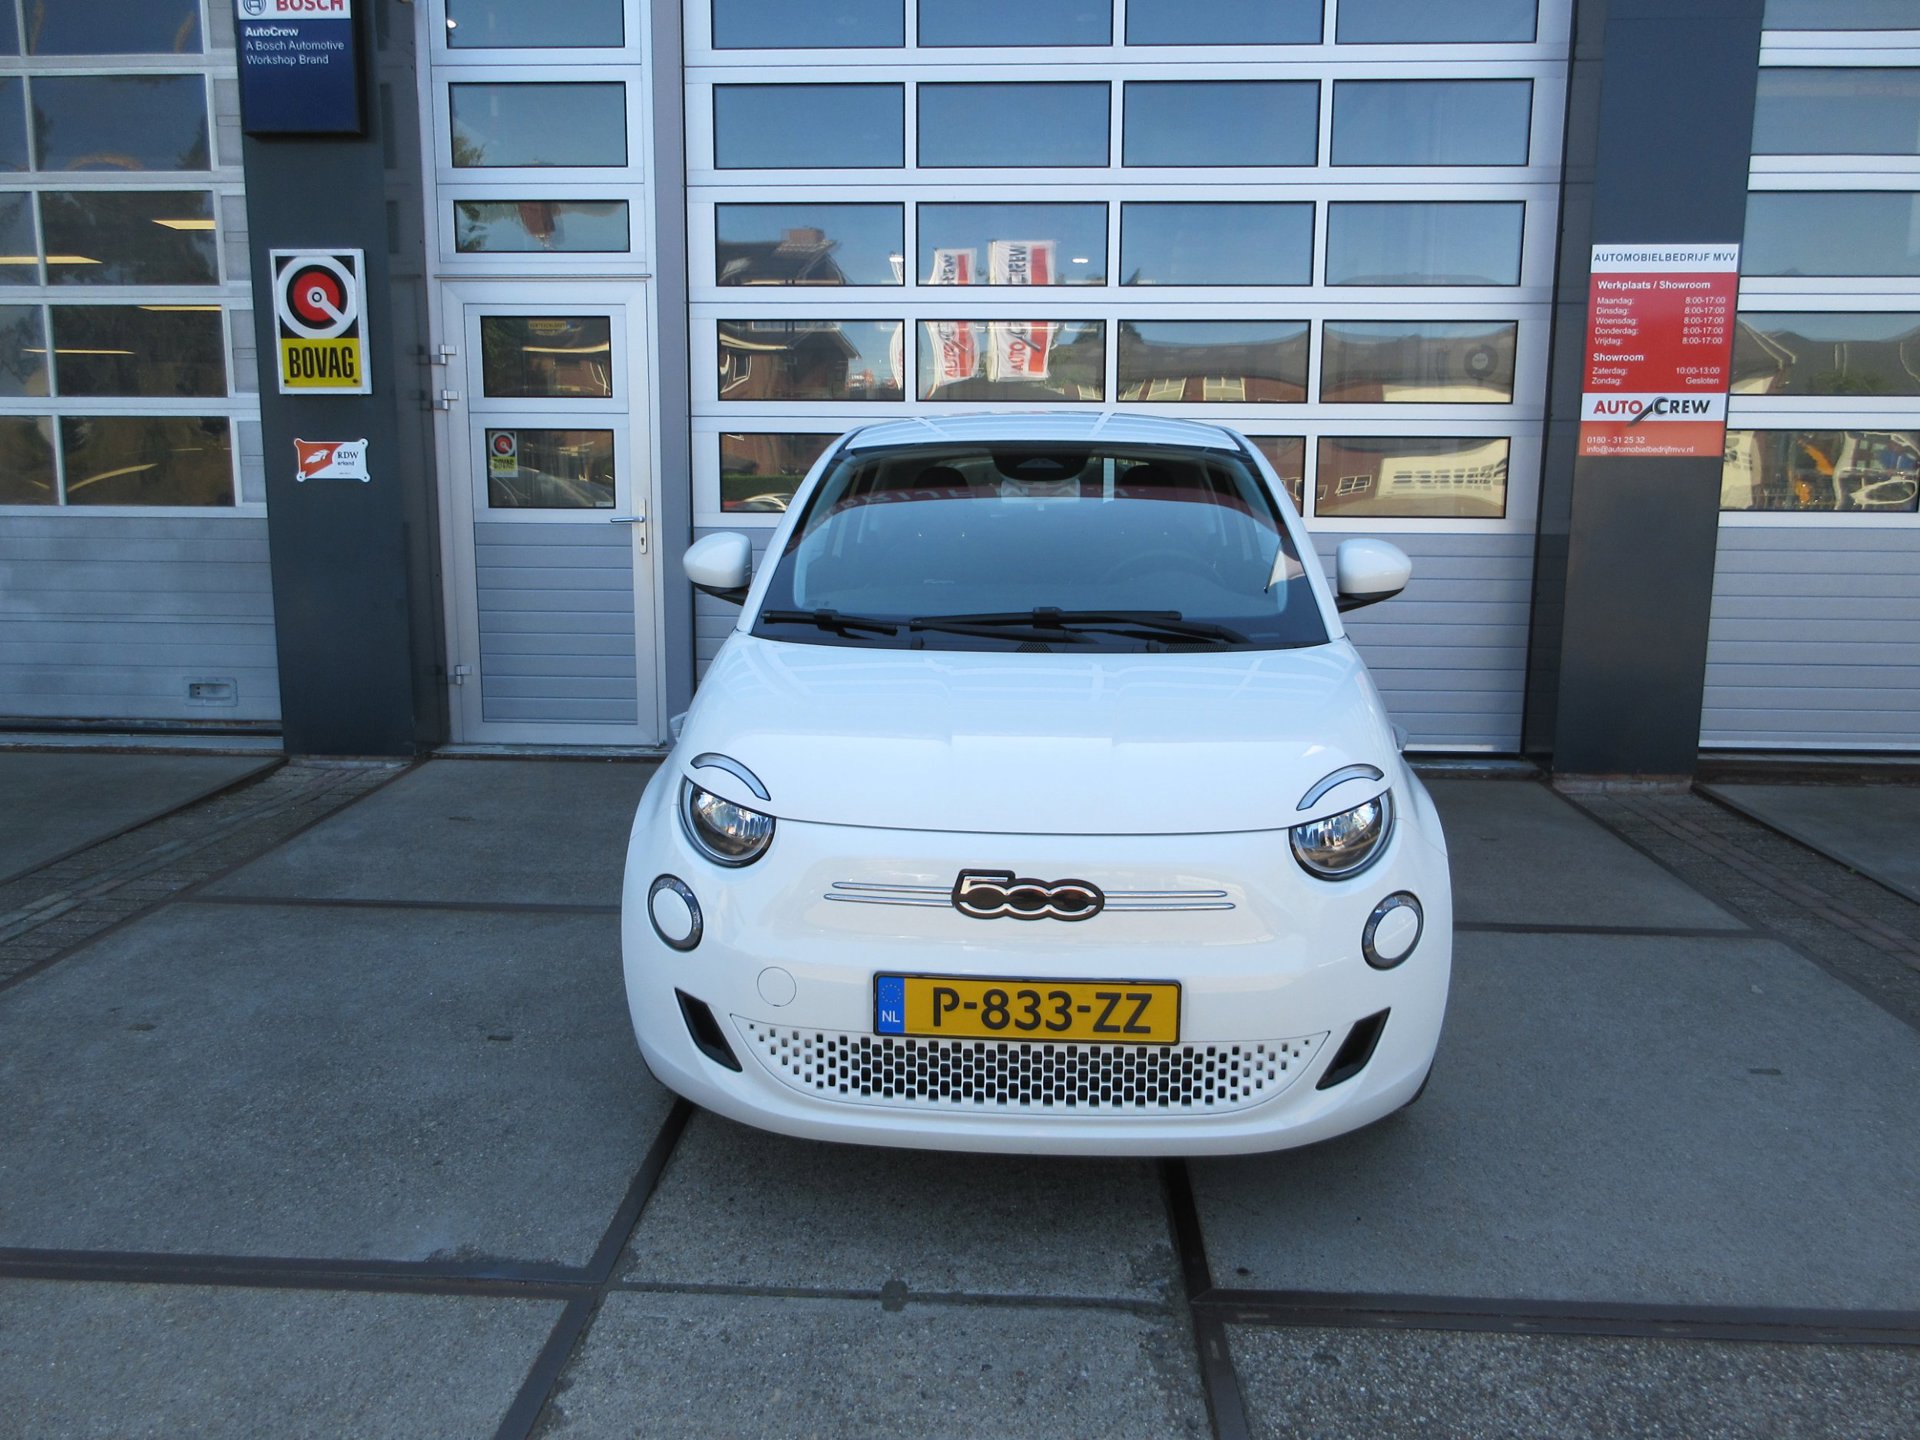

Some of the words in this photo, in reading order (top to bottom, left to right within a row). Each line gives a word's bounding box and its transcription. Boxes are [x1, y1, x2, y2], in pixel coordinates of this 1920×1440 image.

[276, 0, 344, 11] BOSCH
[245, 27, 299, 37] AutoCrew
[246, 41, 254, 51] A
[255, 41, 286, 51] Bosch
[288, 40, 345, 50] Automotive
[246, 55, 297, 67] Workshop
[299, 54, 329, 65] Brand
[1594, 253, 1710, 262] AUTOMOBIELBEDRIJF
[1712, 253, 1736, 262] MVV
[1597, 281, 1650, 291] Werkplaats
[1659, 281, 1711, 290] Showroom
[1685, 297, 1726, 305] 8:00-17:00
[1684, 307, 1725, 315] 8:00-17:00
[1683, 317, 1724, 325] 8:00-17:00
[1683, 327, 1723, 335] 8:00-17:00
[1682, 337, 1723, 345] 8:00-17:00
[1592, 353, 1645, 362] Showroom
[288, 346, 354, 379] BOVAG
[1592, 367, 1628, 376] Zaterdag:
[1676, 367, 1720, 375] 10:00-13:00
[1591, 377, 1623, 386] Zondag:
[1685, 377, 1719, 385] Gesloten
[1593, 400, 1643, 414] AUTO
[1653, 398, 1711, 415] CREW
[1612, 436, 1622, 444] 31
[1624, 436, 1634, 444] 25
[1635, 436, 1645, 444] 32
[337, 451, 359, 460] RDW
[956, 871, 1101, 918] 500
[932, 986, 1153, 1035] P-833-ZZ
[882, 1010, 900, 1023] NL
